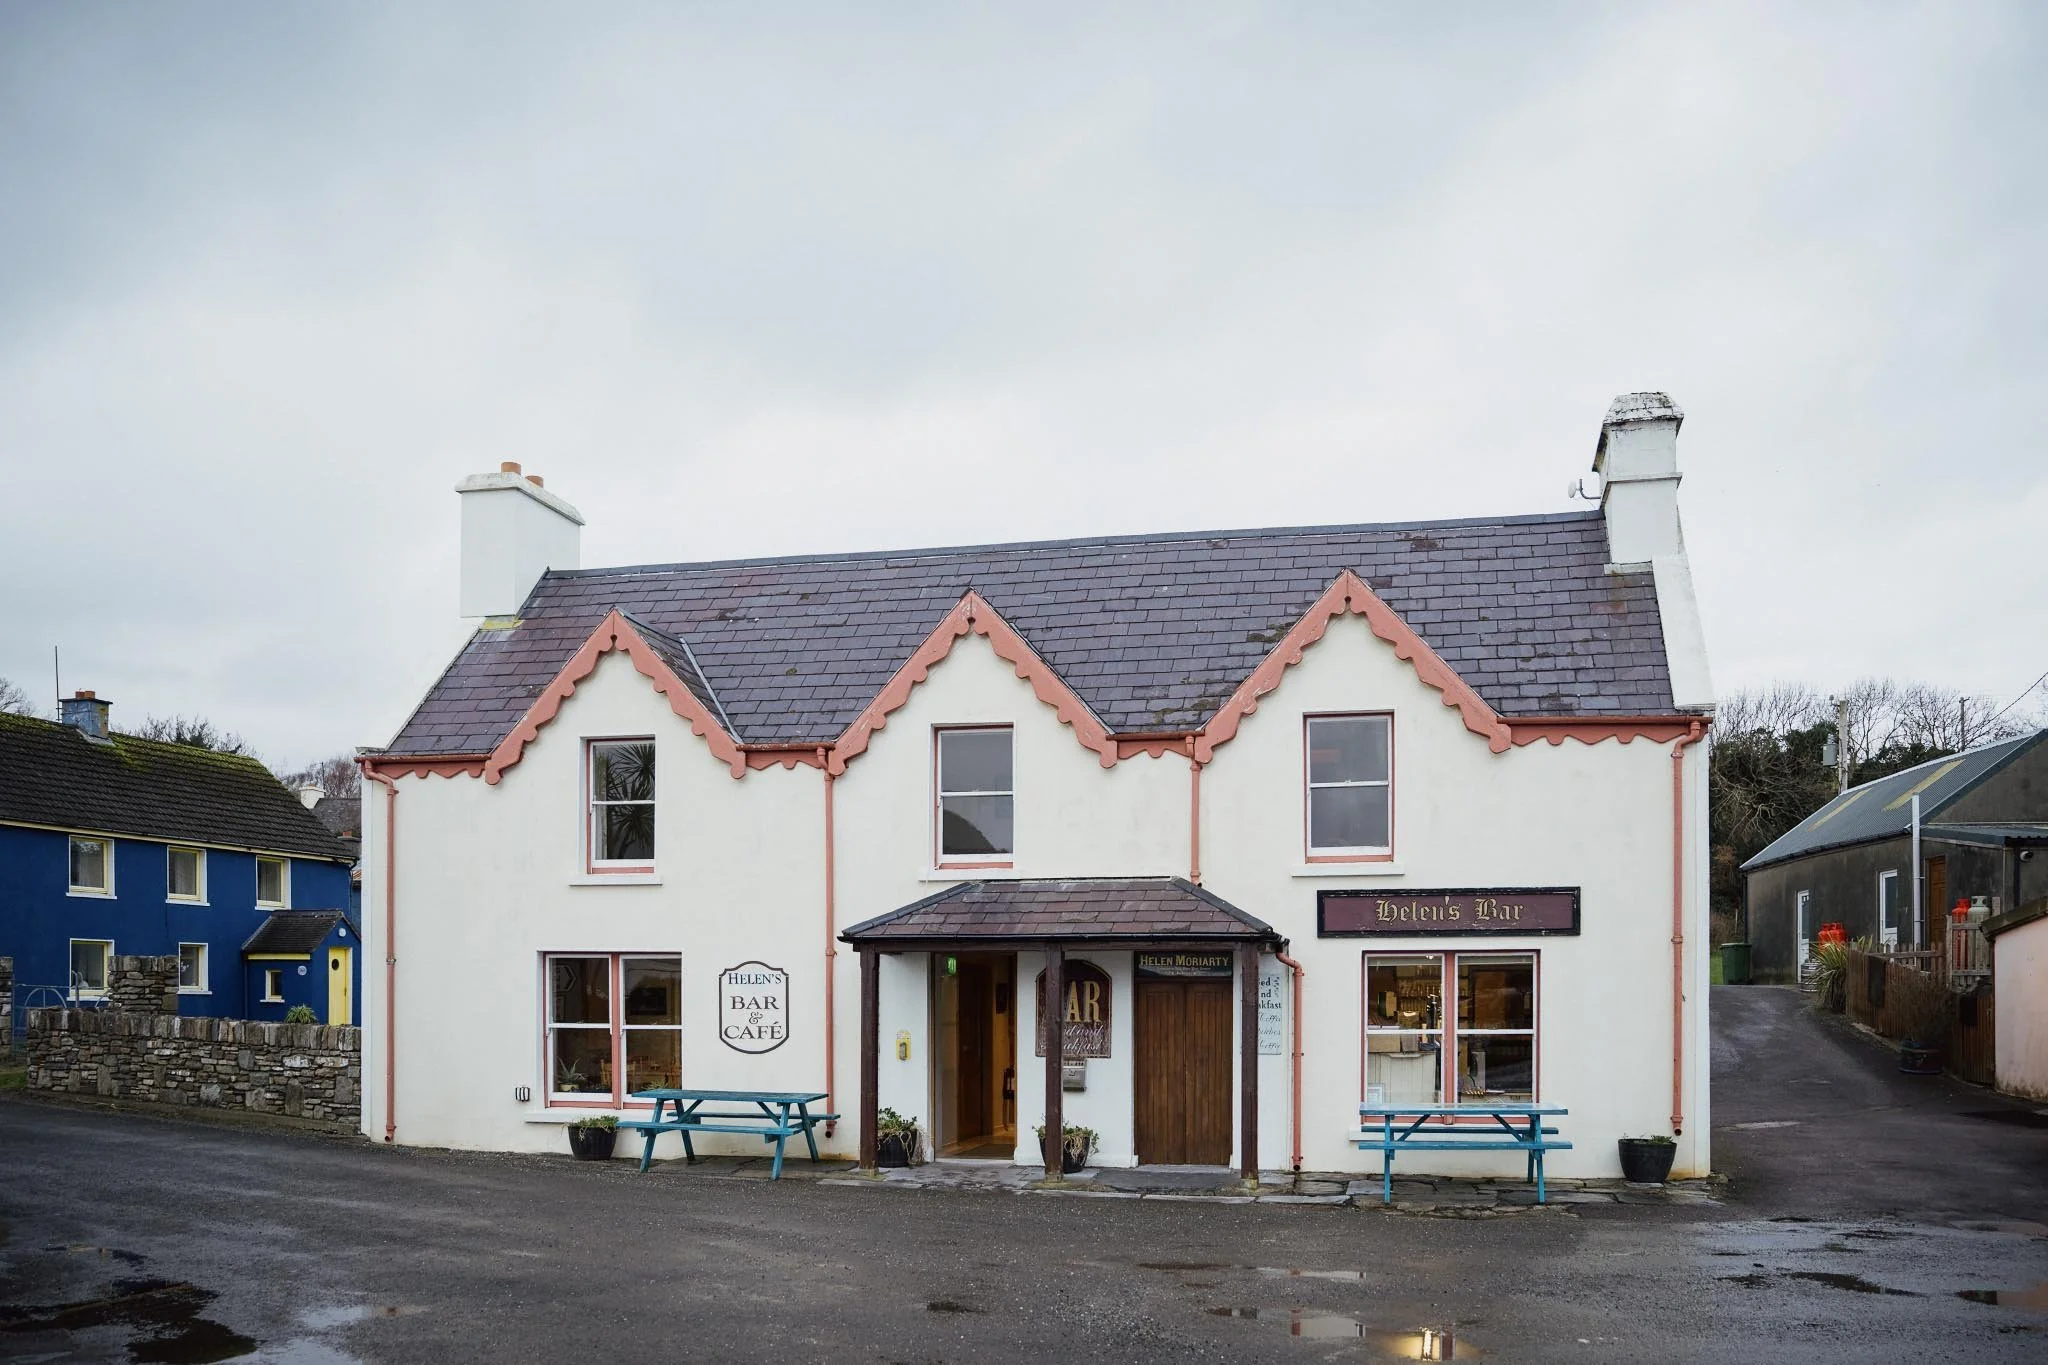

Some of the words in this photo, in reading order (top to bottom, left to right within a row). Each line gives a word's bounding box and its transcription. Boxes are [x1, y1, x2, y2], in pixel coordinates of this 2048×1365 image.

[1375, 896, 1461, 926] Helen's
[1474, 898, 1524, 922] Bar
[1140, 954, 1173, 966] HELEN
[1175, 954, 1230, 967] MORIARTY
[728, 972, 782, 985] HELEN'S
[1259, 976, 1271, 986] ed
[1260, 988, 1272, 998] nd
[730, 995, 780, 1010] BAR
[1062, 979, 1101, 1022] AR
[748, 1011, 764, 1025] &
[723, 1021, 784, 1040] CAFÉ
